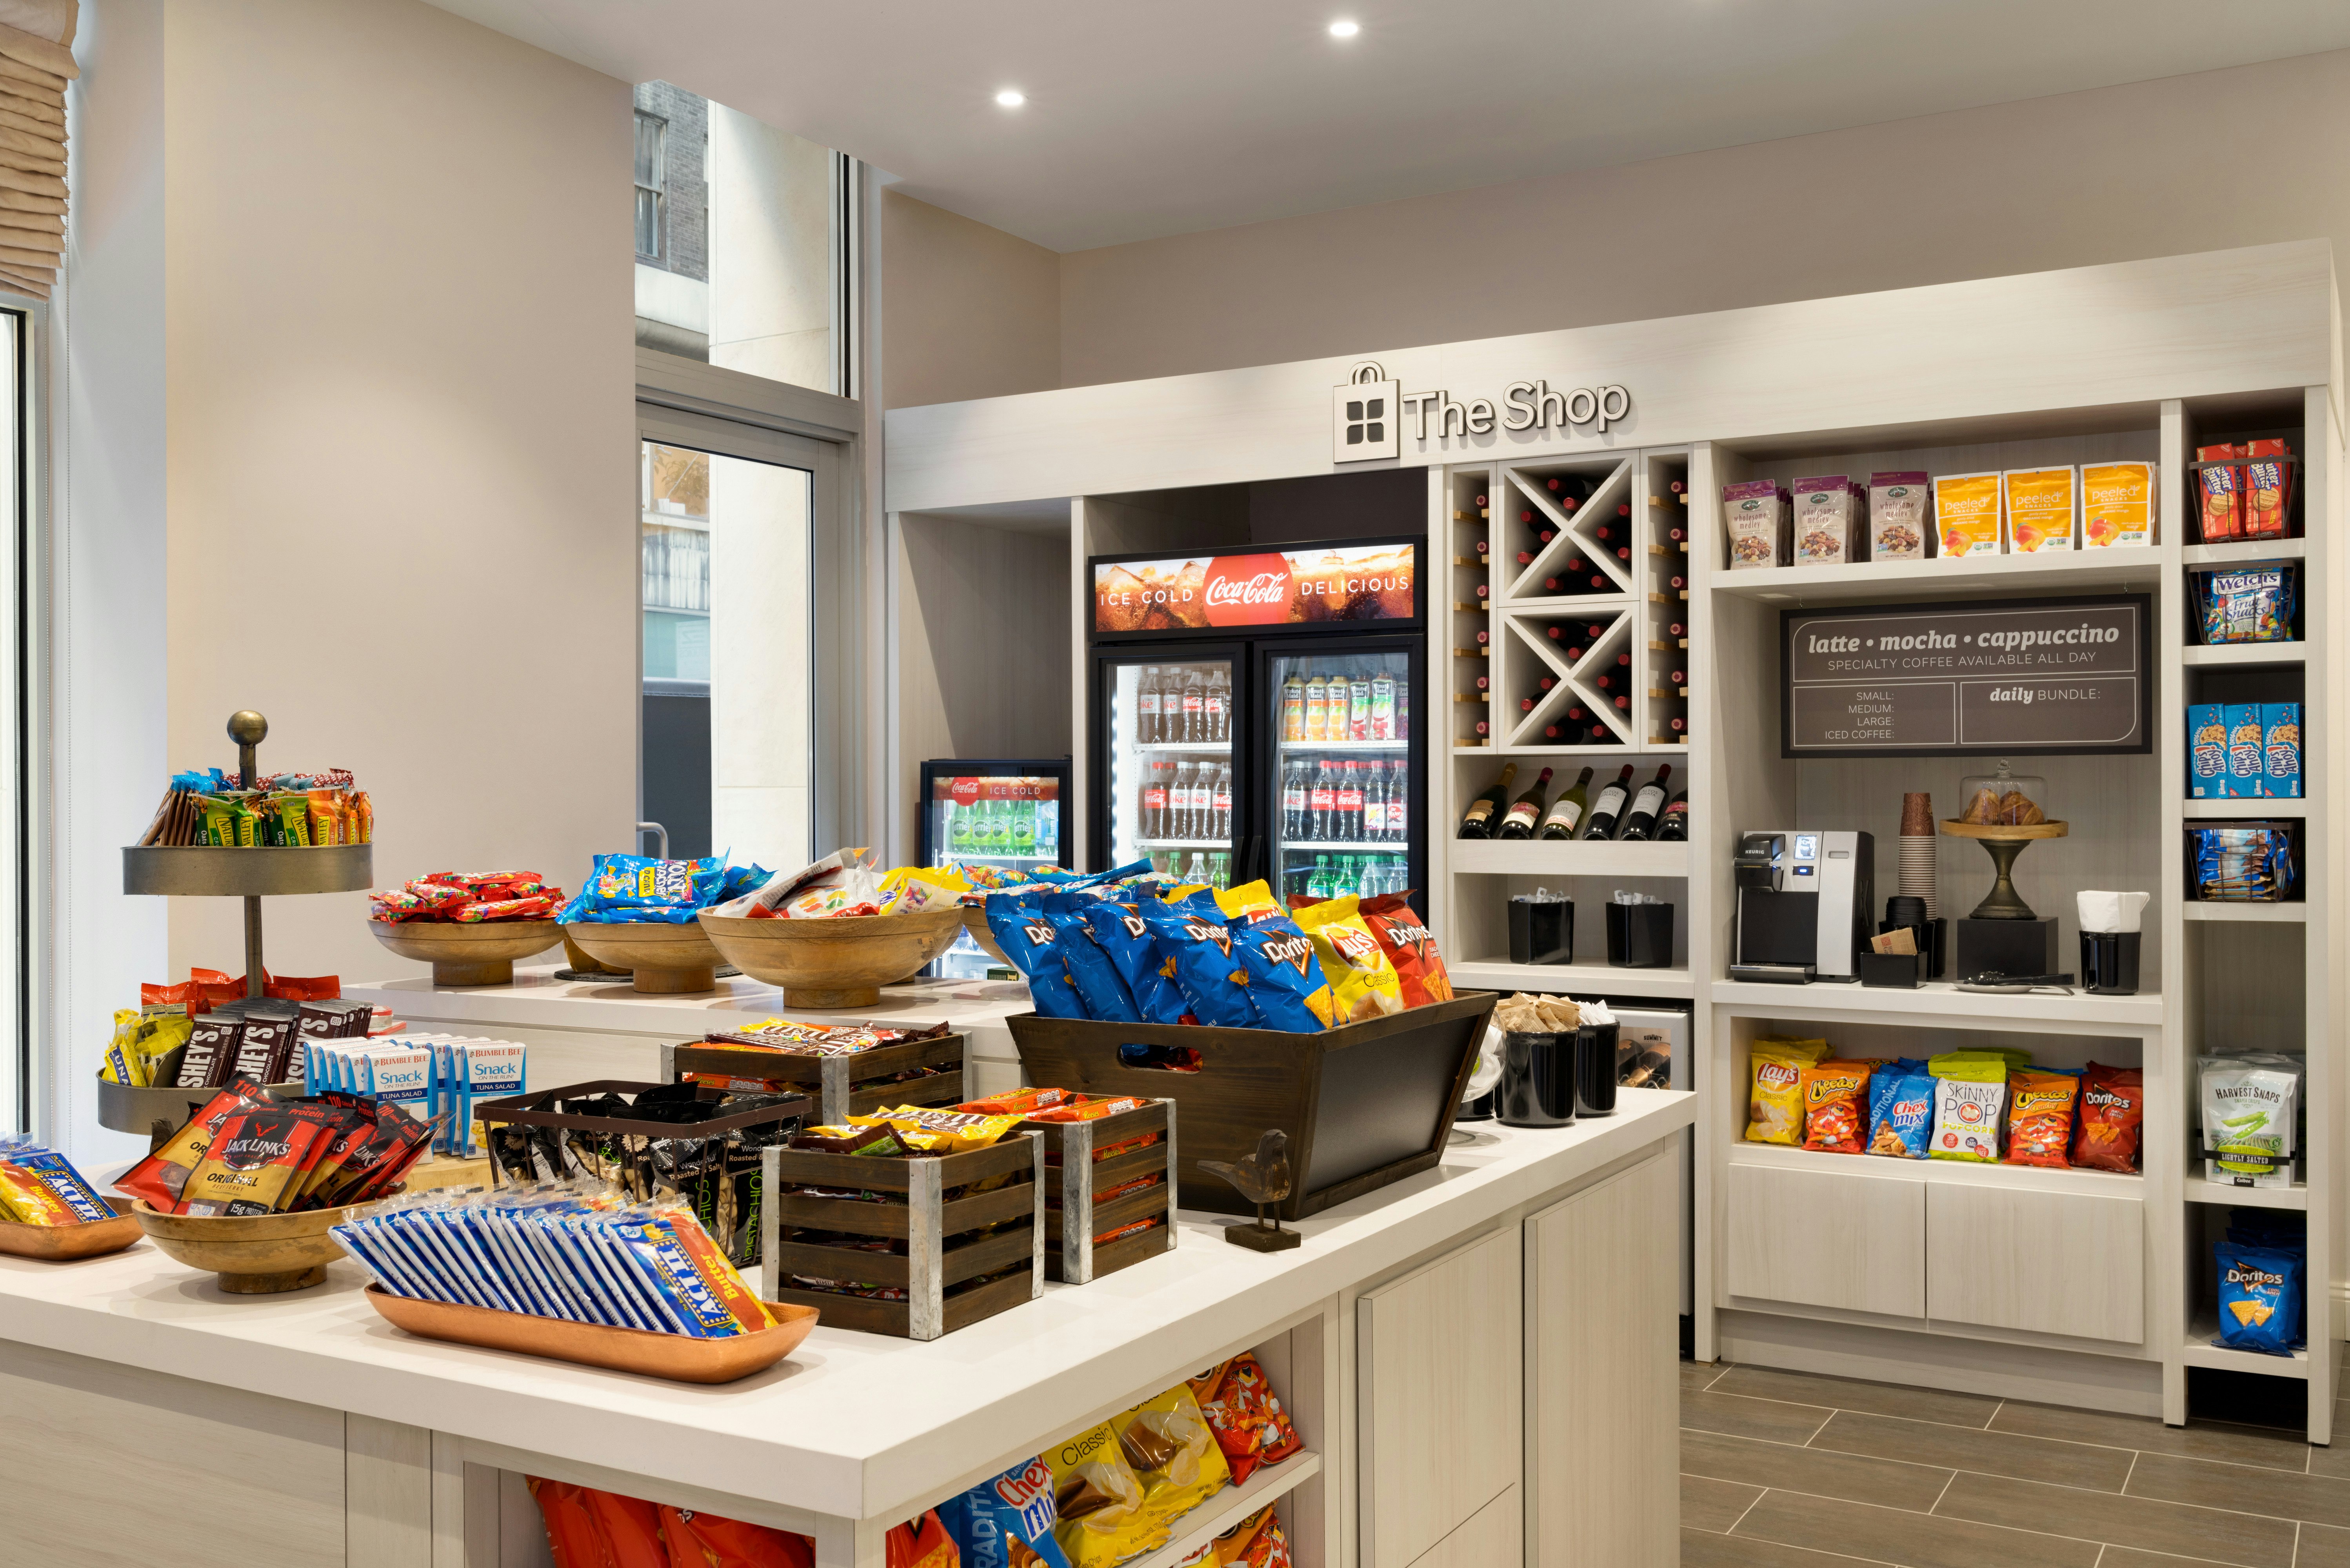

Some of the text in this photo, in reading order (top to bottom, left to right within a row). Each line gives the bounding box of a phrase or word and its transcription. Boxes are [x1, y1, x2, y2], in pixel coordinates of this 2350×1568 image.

[1403, 380, 1630, 440] The Shop
[2203, 468, 2225, 495] Butter
[2251, 463, 2270, 490] Butter
[2016, 492, 2059, 507] peeled
[2092, 485, 2136, 502] peeled
[1802, 507, 1836, 517] wholesome
[1880, 501, 1914, 510] wholesome
[1945, 497, 1987, 513] peeled
[1734, 512, 1766, 522] wholesome
[1886, 510, 1908, 518] medley
[1739, 521, 1761, 529] medley
[1206, 572, 1289, 606] Coca-Cola
[1301, 576, 1409, 595] DELICIOUS
[2219, 574, 2277, 590] Welch's
[1101, 589, 1193, 606] ICE COLD
[2234, 598, 2261, 610] Fruit
[2227, 606, 2265, 621] Snacks
[1808, 623, 2119, 653] latte mocha cappuccino
[1828, 652, 2096, 670] SPECIALTY COFFEE AVAILABLE ALL DAY
[1856, 692, 1894, 701] SMALL:
[1990, 688, 2101, 704] daily BUNDLE:
[1848, 704, 1894, 713] MEDIUM:
[1857, 717, 1894, 726] LARGE:
[1825, 730, 1894, 739] ICED COFFEE:
[2194, 726, 2205, 745] ORIGINAL
[2229, 725, 2241, 745] ORIGINAL
[2265, 725, 2277, 745] ORIGINAL
[952, 782, 978, 793] Coca-Cola
[241, 817, 250, 846] VALLEY
[319, 817, 327, 846] VALLEY
[1390, 926, 1432, 946] Doritos
[1363, 971, 1395, 987] Classic
[177, 1031, 218, 1087] SHEY'S
[380, 1056, 413, 1066] BUMBLE
[475, 1049, 507, 1058] BUMBLE
[205, 1058, 217, 1085] CHOCOLATE
[263, 1055, 274, 1083] CHOCOLATE
[474, 1063, 516, 1076] Snack
[1759, 1063, 1798, 1083] Lay's
[380, 1070, 423, 1084] Snack
[401, 1090, 422, 1098] SALAD
[1759, 1091, 1787, 1102] Classic
[1810, 1077, 1859, 1102] Cheetos
[1822, 1091, 1845, 1103] Crunchy
[1947, 1083, 1998, 1103] SKINNY
[2216, 1087, 2280, 1103] HARVEST SNAPS
[328, 1095, 342, 1108] 110
[1013, 1102, 1028, 1111] Reese's
[1893, 1100, 1927, 1114] Chex
[2015, 1091, 2070, 1109] Cheetos
[2030, 1102, 2057, 1112] Crunchy
[2086, 1092, 2130, 1109] Doritos
[289, 1109, 325, 1118] Protein
[358, 1105, 374, 1118] Protein
[377, 1105, 394, 1117] 110
[1084, 1110, 1099, 1119] Reese's
[1894, 1111, 1924, 1126] mix
[1944, 1098, 1996, 1125] POP
[400, 1125, 418, 1139] Protein
[1942, 1122, 1995, 1134] POPCORN
[222, 1139, 291, 1155] JACK LINK'S
[1103, 1148, 1120, 1159] Reese's
[2222, 1154, 2268, 1164] LIGHTLY SALTED
[207, 1173, 258, 1187] ORIGINAL
[48, 1178, 85, 1205] ACT
[29, 1186, 63, 1214] Butter
[231, 1204, 263, 1216] 15g PROTEIN
[700, 1254, 740, 1300] Butter
[2228, 1269, 2283, 1284] Doritos
[678, 1274, 723, 1315] ACT
[1061, 1427, 1112, 1466] Classic
[996, 1455, 1052, 1506] Chex
